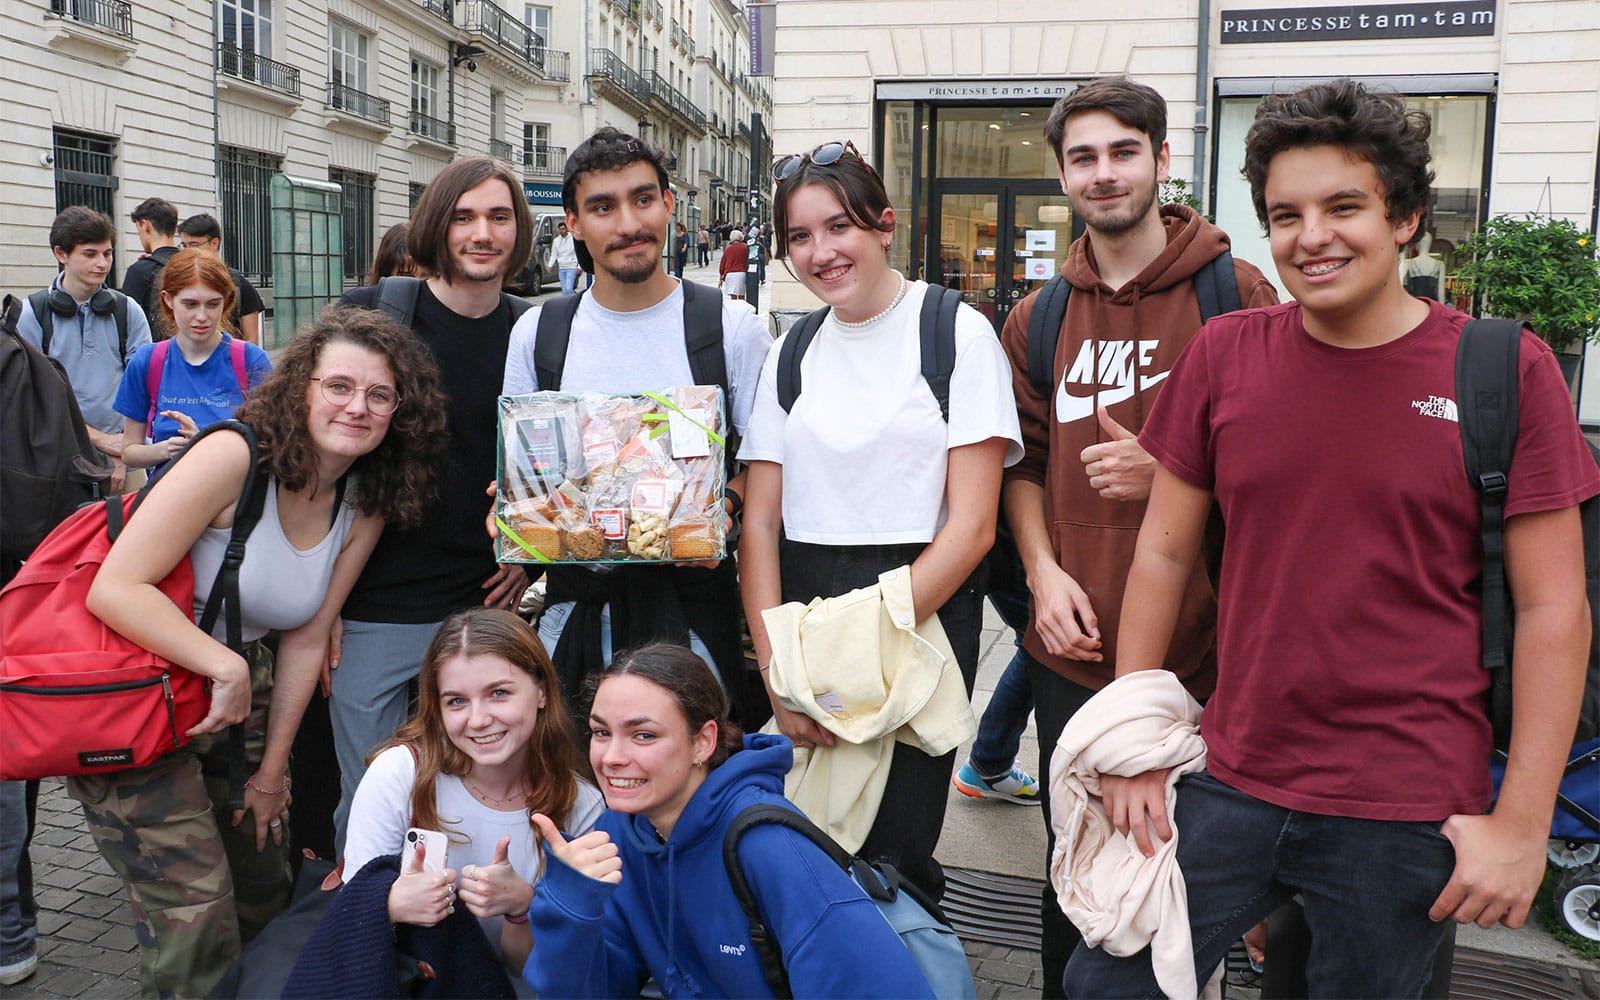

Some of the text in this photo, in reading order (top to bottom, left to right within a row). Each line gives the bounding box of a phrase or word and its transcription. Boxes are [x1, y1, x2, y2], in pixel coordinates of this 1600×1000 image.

[1223, 16, 1351, 33] PRINCESSE
[1066, 339, 1159, 387] NIKE
[1428, 395, 1446, 404] THE
[1411, 400, 1445, 411] NORTH
[1419, 408, 1443, 418] FACE
